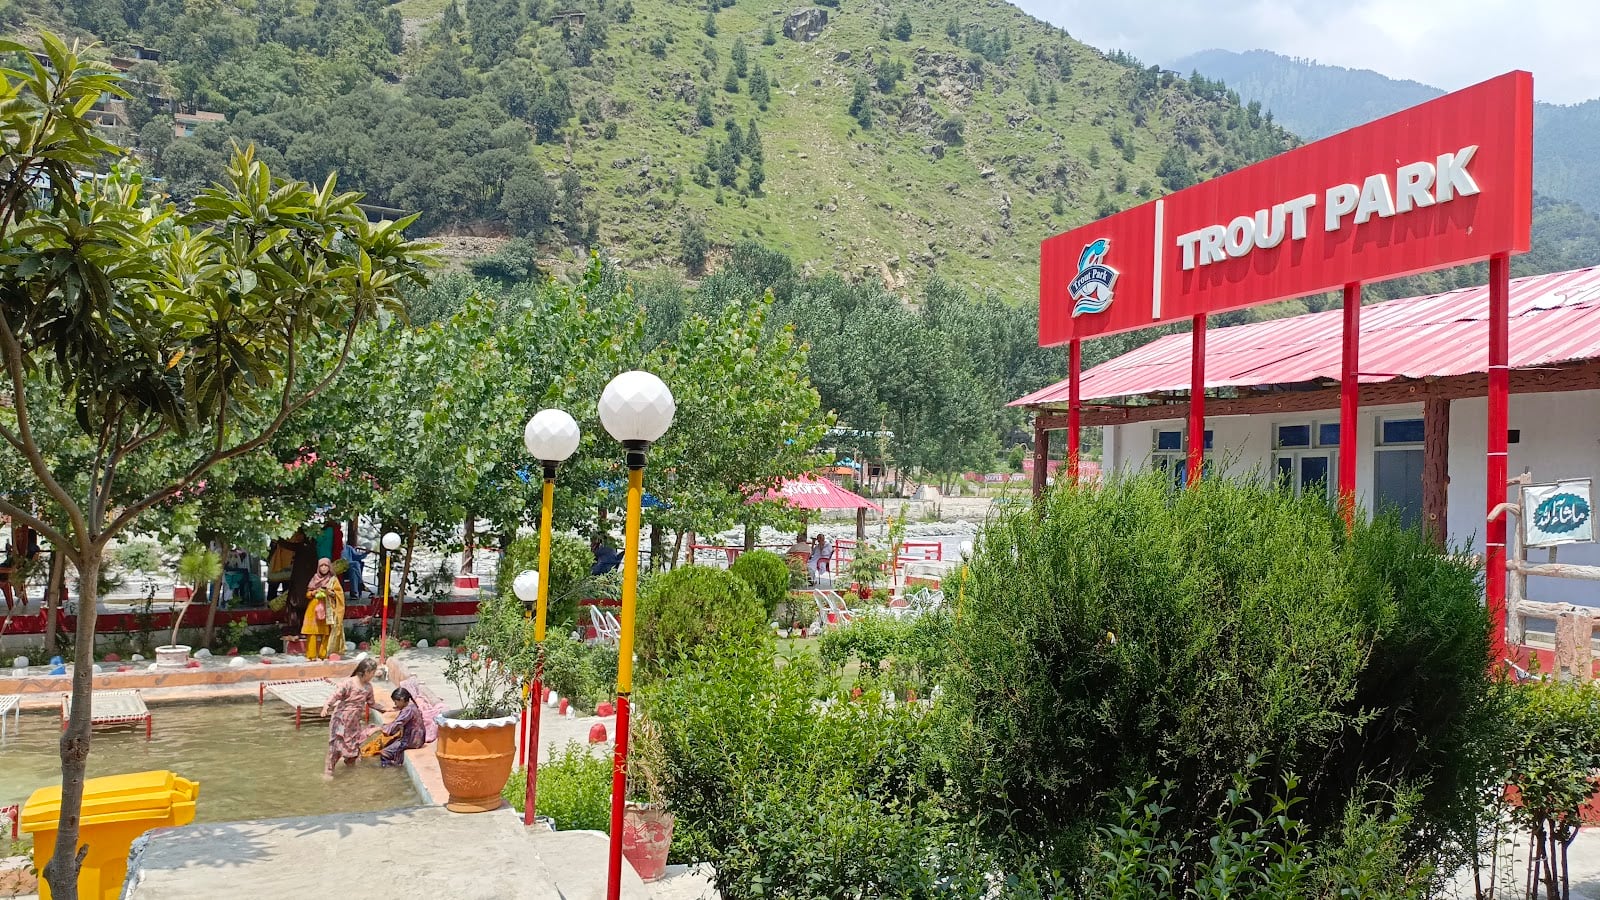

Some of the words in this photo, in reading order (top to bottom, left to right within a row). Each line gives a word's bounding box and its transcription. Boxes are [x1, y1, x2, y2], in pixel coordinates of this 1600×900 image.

[1176, 194, 1316, 271] TROUT
[1325, 145, 1480, 232] PARK
[1073, 274, 1091, 290] Trout
[1092, 268, 1107, 281] Park
